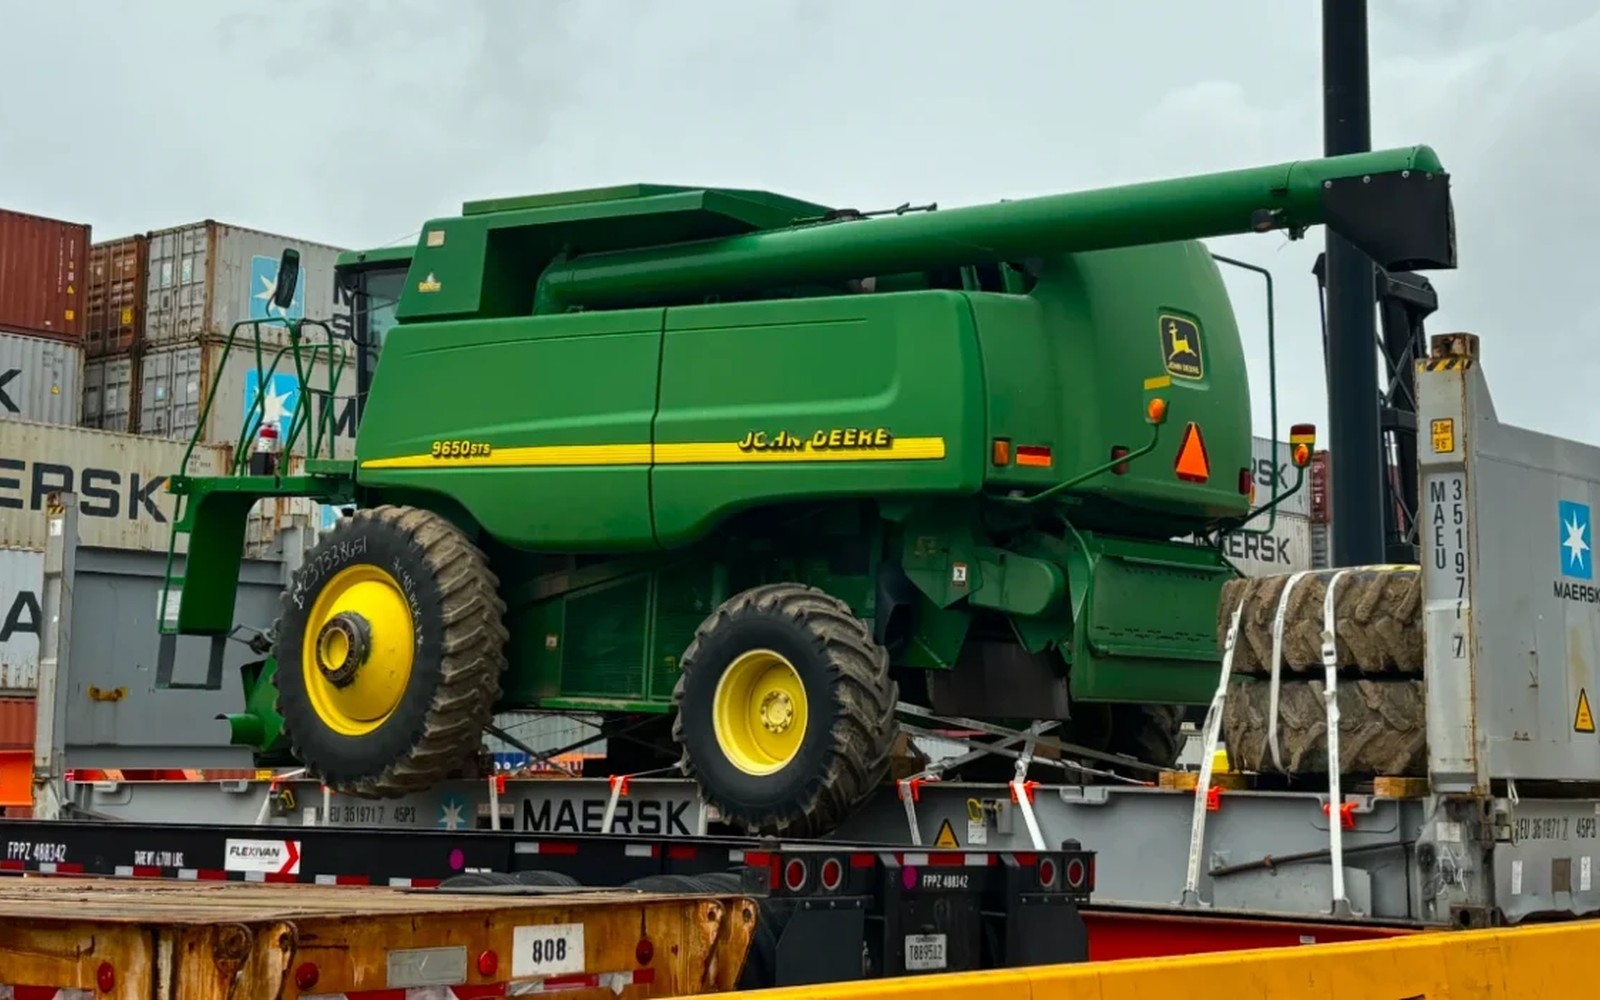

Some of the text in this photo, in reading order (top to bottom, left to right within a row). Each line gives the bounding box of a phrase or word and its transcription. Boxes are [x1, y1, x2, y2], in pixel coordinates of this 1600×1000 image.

[811, 428, 893, 451] DEERE
[1430, 481, 1446, 570] MAEU
[1222, 531, 1291, 565] ERSK
[522, 798, 691, 836] MAERSK
[7, 841, 31, 861] FPPZ
[229, 845, 281, 858] FLEXIVAN
[532, 937, 567, 965] 808
